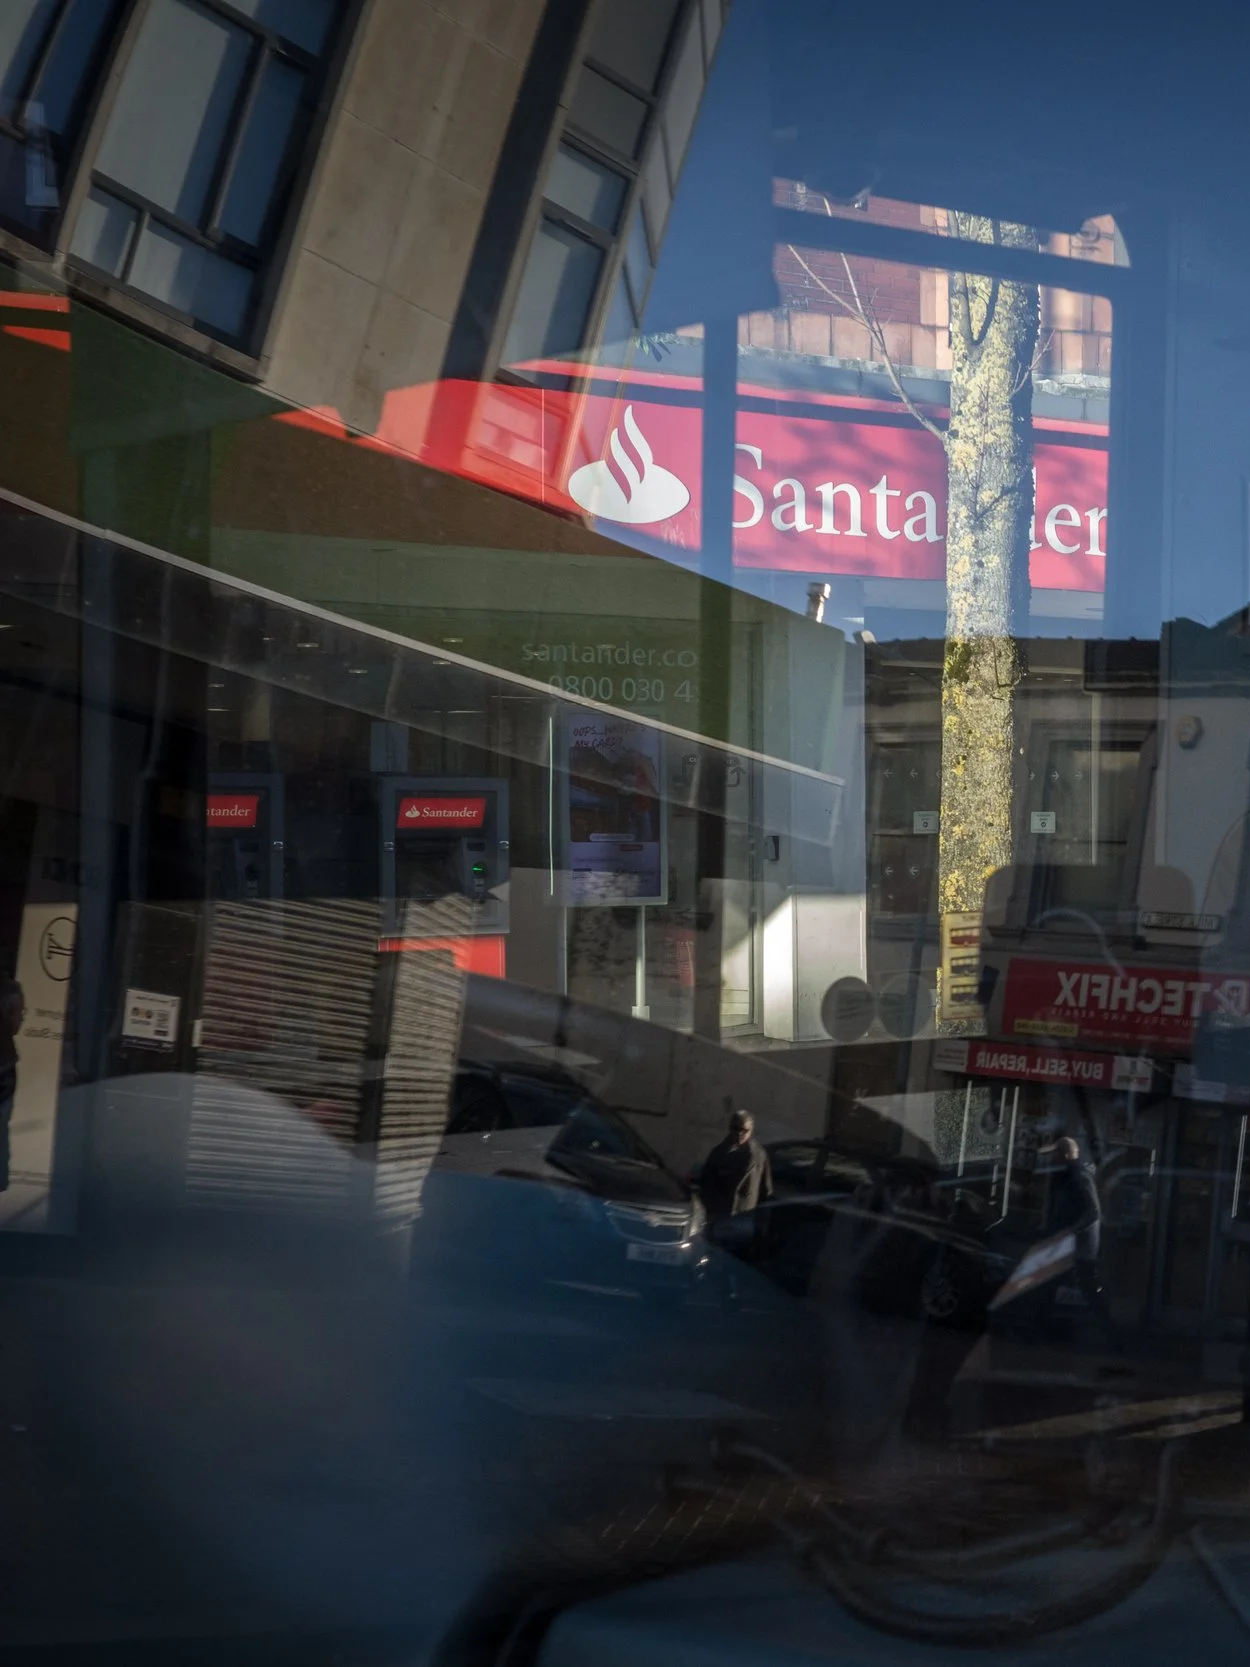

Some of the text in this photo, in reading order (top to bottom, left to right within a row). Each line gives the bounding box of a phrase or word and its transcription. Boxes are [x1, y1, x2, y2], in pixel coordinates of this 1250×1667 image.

[732, 443, 1108, 557] Santaer
[548, 675, 613, 700] 0800
[621, 678, 664, 701] 030
[422, 805, 479, 818] Santander
